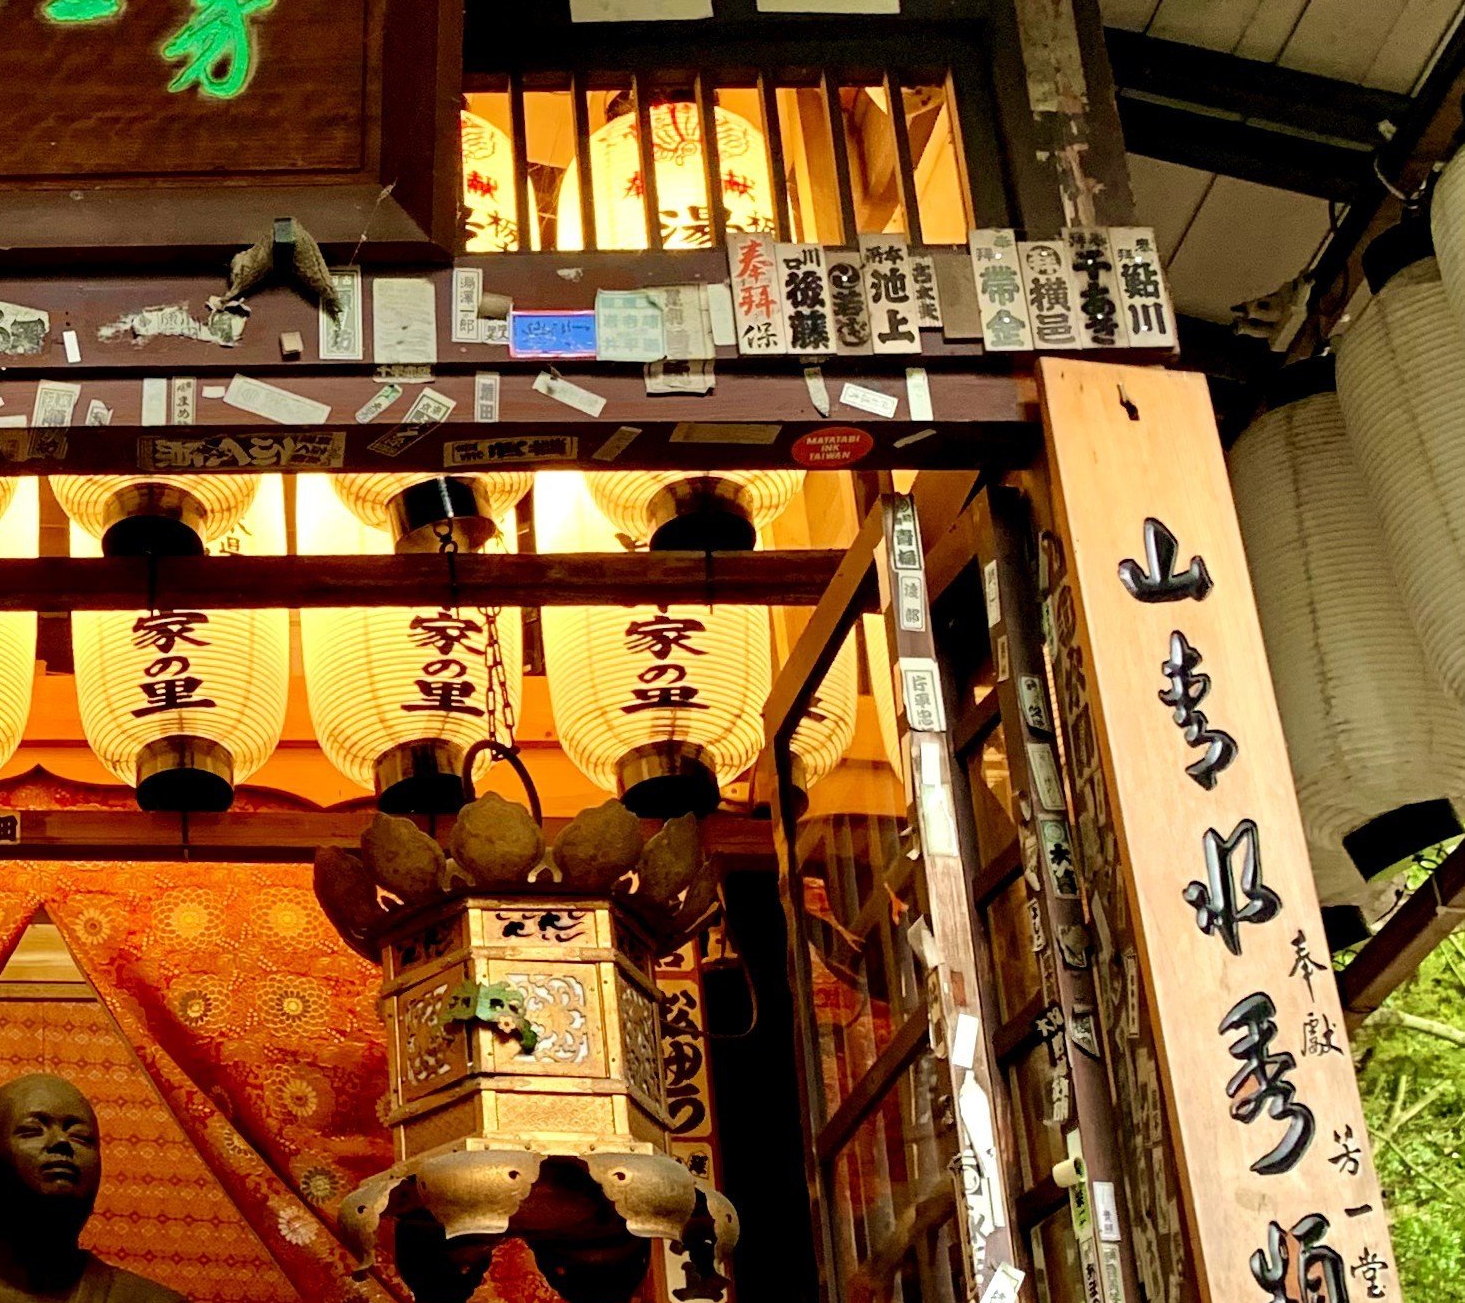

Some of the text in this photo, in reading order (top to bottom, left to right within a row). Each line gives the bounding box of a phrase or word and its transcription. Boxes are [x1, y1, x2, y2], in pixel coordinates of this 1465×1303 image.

[736, 239, 778, 320] 奉拝
[785, 270, 831, 350] 後藤
[869, 267, 916, 345] 池上
[805, 433, 861, 448] MATATABI
[807, 450, 851, 462] TAIWAN
